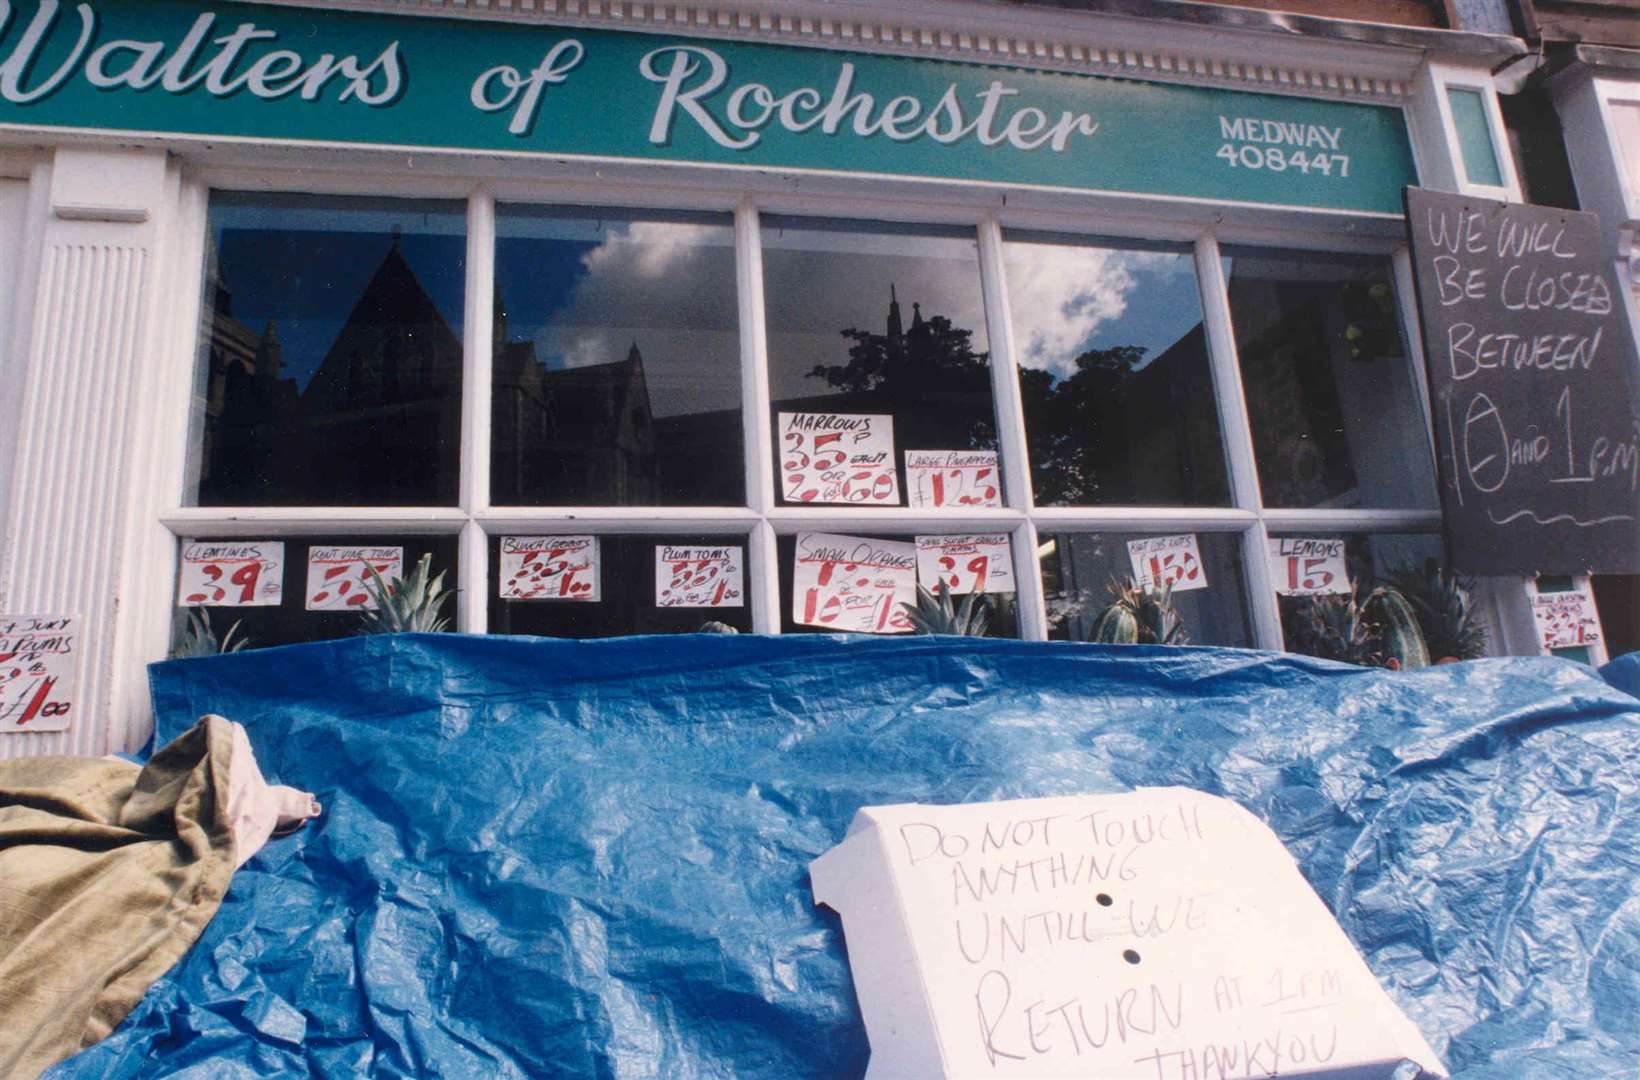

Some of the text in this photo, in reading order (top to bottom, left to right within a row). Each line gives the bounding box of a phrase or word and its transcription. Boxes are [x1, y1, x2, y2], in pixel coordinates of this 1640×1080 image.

[0, 2, 1100, 151] Walters of Rochester
[1219, 115, 1343, 151] MEDWAY
[1216, 143, 1351, 178] 408447
[1427, 207, 1577, 258] WE WILL
[1433, 256, 1486, 305] BE
[1448, 323, 1603, 380] BETWEEN
[787, 413, 872, 432] MARROWS
[662, 546, 692, 561] PLUM
[1280, 537, 1344, 558] LEMONS
[899, 804, 1203, 866] DO NOT TOUCH
[952, 845, 1140, 906] ANYTHING
[955, 910, 1097, 964] UNTILL
[975, 969, 1183, 1067] RETURN
[1213, 975, 1244, 1013] AT
